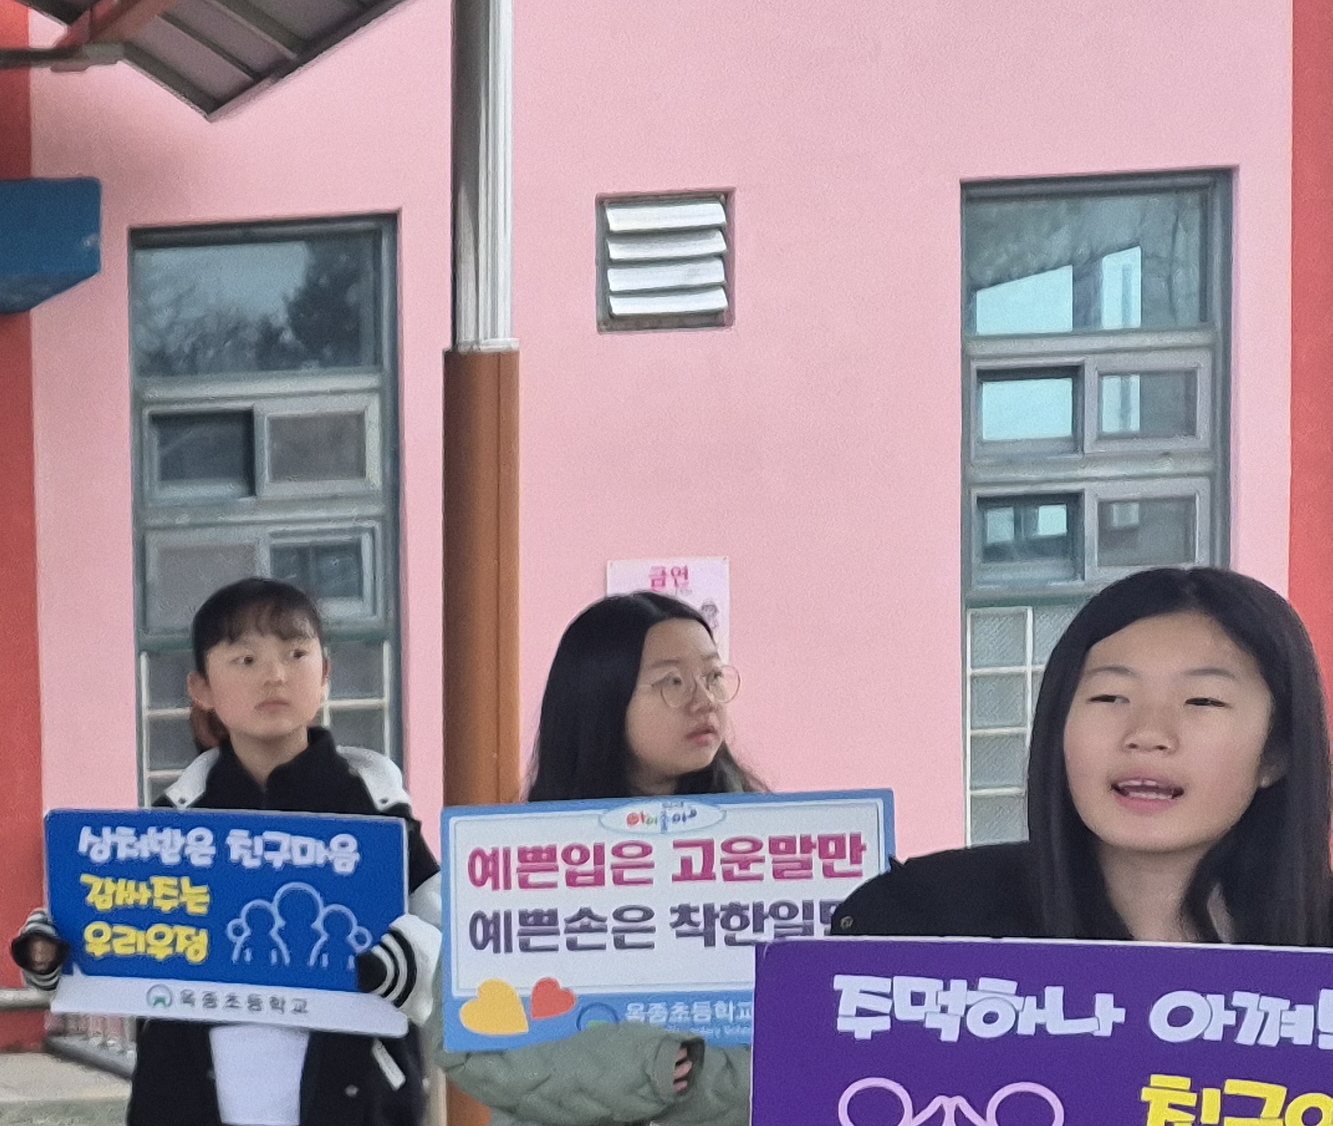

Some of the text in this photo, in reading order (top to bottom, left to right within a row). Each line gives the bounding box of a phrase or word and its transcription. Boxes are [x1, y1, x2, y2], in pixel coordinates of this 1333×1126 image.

[648, 565, 690, 592] 금연
[78, 826, 361, 875] 상처받은 친구마음
[466, 832, 867, 891] 예쁜입은 고운말만
[79, 874, 212, 915] 감싸주는
[82, 920, 210, 965] 우리우정
[468, 899, 847, 954] 예쁜손은 착한일
[179, 988, 310, 1016] 옥종초등학교
[833, 974, 1125, 1042] 주먹하나
